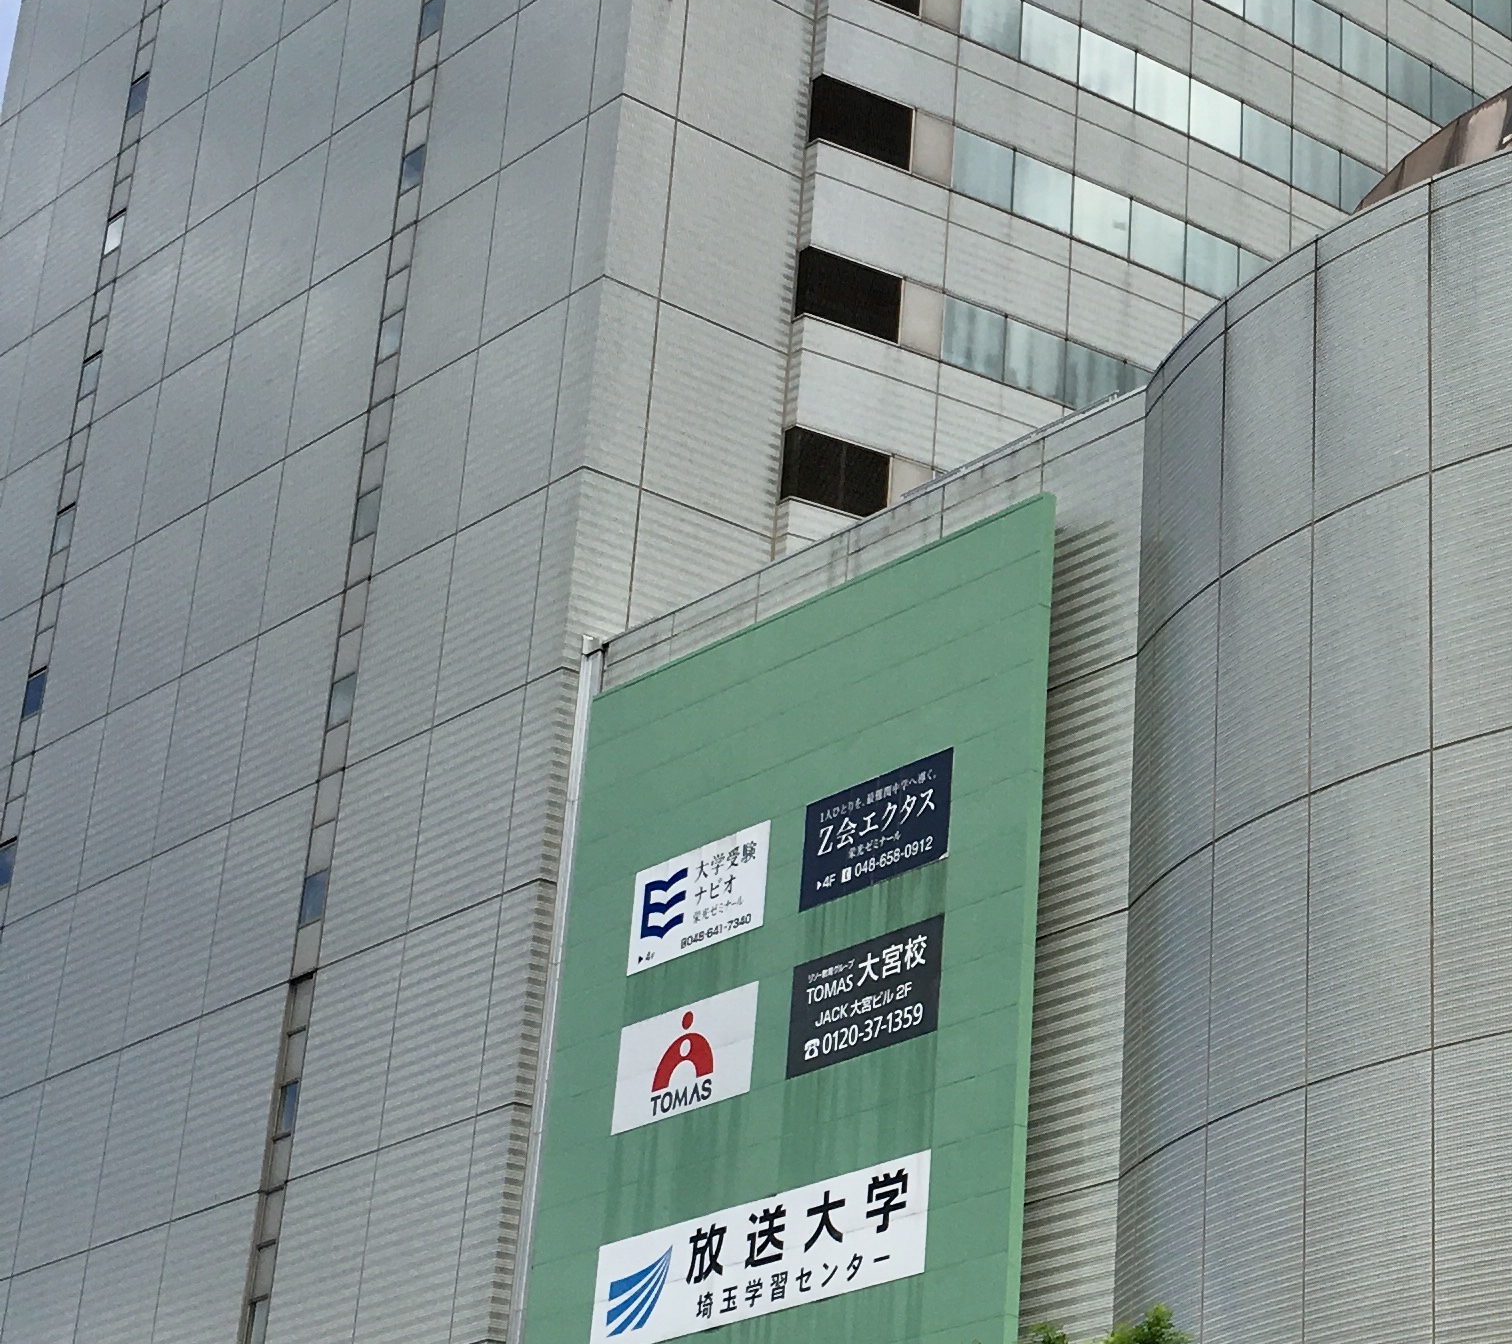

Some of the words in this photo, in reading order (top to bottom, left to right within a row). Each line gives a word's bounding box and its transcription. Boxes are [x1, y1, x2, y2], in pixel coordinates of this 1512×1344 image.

[817, 788, 935, 857] Z会エクタス
[694, 840, 757, 884] 大学受験
[822, 873, 837, 888] 4F
[854, 835, 934, 878] 048-658-0912
[806, 974, 854, 1005] TOMAS
[857, 934, 928, 987] 大宮校
[814, 1003, 849, 1027] JACK
[849, 988, 894, 1017] 大宮ビル
[895, 981, 913, 1000] 2F
[822, 1003, 924, 1055] 0120-37-1359
[650, 1078, 712, 1116] TOMAS
[685, 1168, 909, 1284] 放送大学
[696, 1253, 890, 1320] 埼玉学習センター
